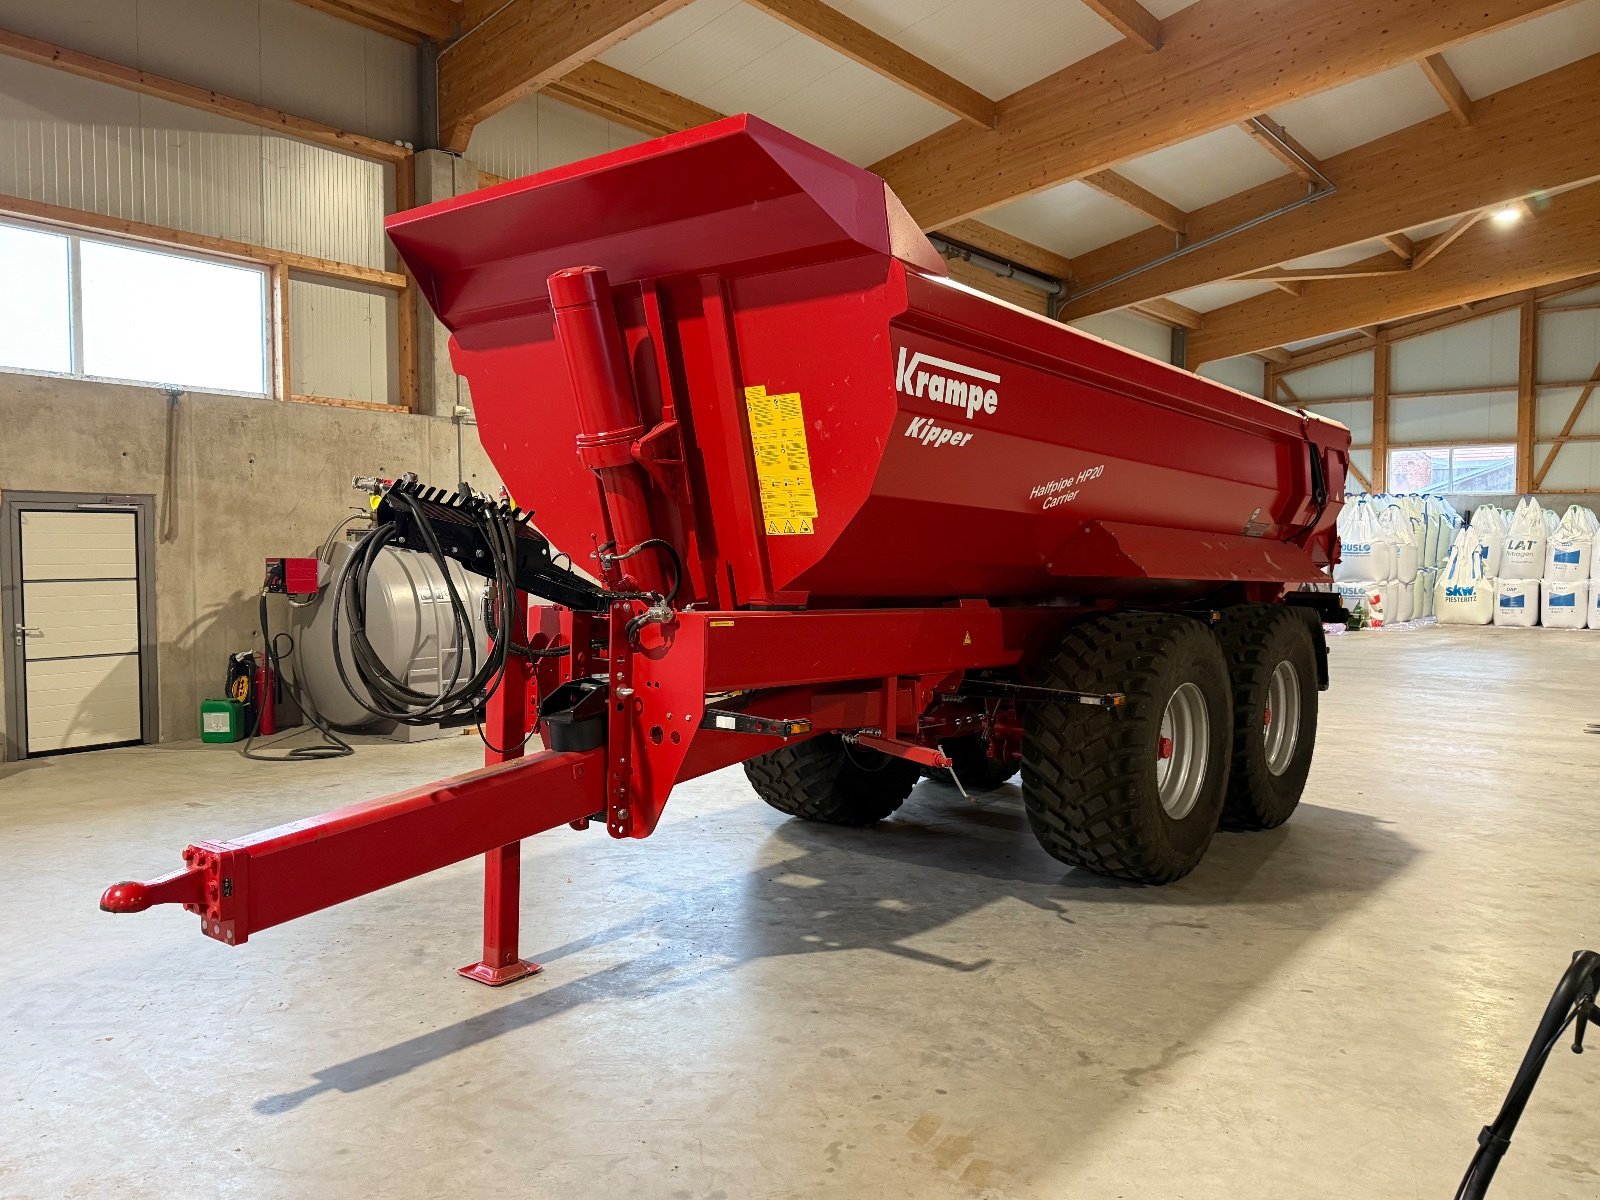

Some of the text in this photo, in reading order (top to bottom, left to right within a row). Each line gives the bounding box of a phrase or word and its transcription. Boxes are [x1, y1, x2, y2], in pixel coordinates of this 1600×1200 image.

[896, 346, 1001, 420] Krampe
[904, 416, 974, 448] Kipper
[1029, 464, 1105, 500] Halfpipe HP20
[1042, 488, 1080, 510] Carrier
[1507, 539, 1534, 551] LAT
